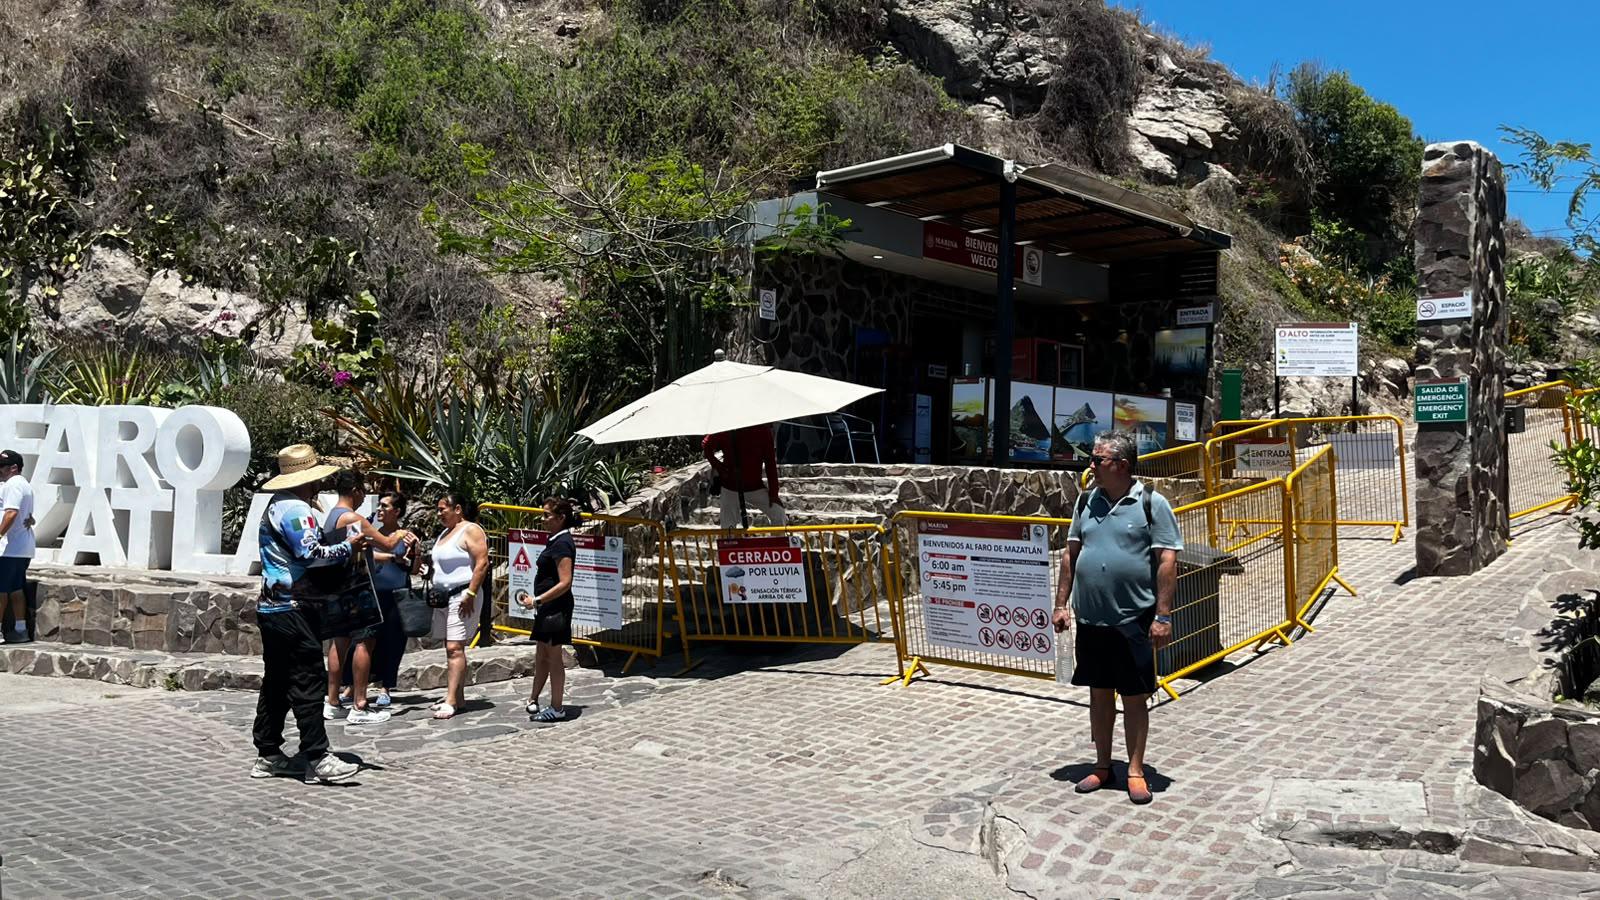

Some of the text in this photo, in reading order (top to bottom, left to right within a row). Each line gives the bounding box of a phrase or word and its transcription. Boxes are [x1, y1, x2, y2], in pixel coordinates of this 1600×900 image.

[965, 236, 998, 254] BIENVEN
[971, 253, 998, 268] WELCO
[923, 540, 964, 550] BIENVENIDOS
[975, 544, 992, 552] FARO
[1004, 545, 1042, 555] MAZATLÁN
[728, 551, 792, 563] CERRADO
[748, 567, 800, 576] POR LLUVIA
[932, 560, 950, 570] 6:00
[952, 563, 964, 572] am
[933, 580, 966, 593] 5:45 pm
